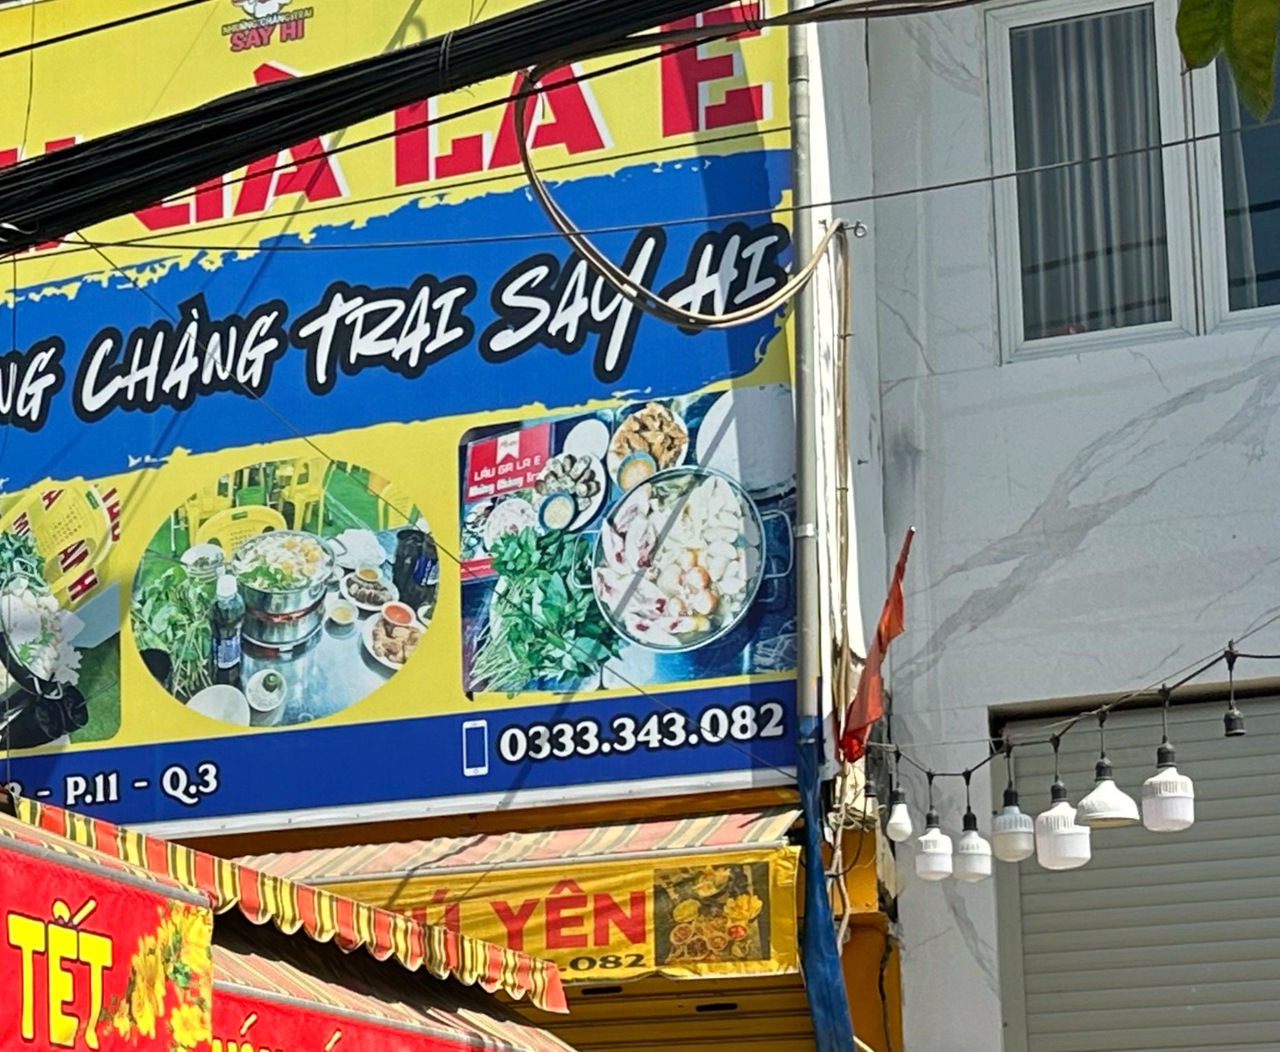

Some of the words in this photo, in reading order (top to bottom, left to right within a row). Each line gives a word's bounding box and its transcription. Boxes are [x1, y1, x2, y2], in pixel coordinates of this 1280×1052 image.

[230, 25, 275, 51] SAY
[280, 19, 304, 42] HI
[80, 308, 280, 413] CHÀNG
[299, 286, 467, 384] TRAI
[488, 236, 656, 372] SAY
[664, 234, 780, 323] HI
[500, 702, 784, 762] 0333.343.082
[65, 773, 118, 805] P.11
[162, 763, 218, 805] Q.3
[490, 879, 648, 952] YÊN
[6, 898, 114, 1050] TẾT
